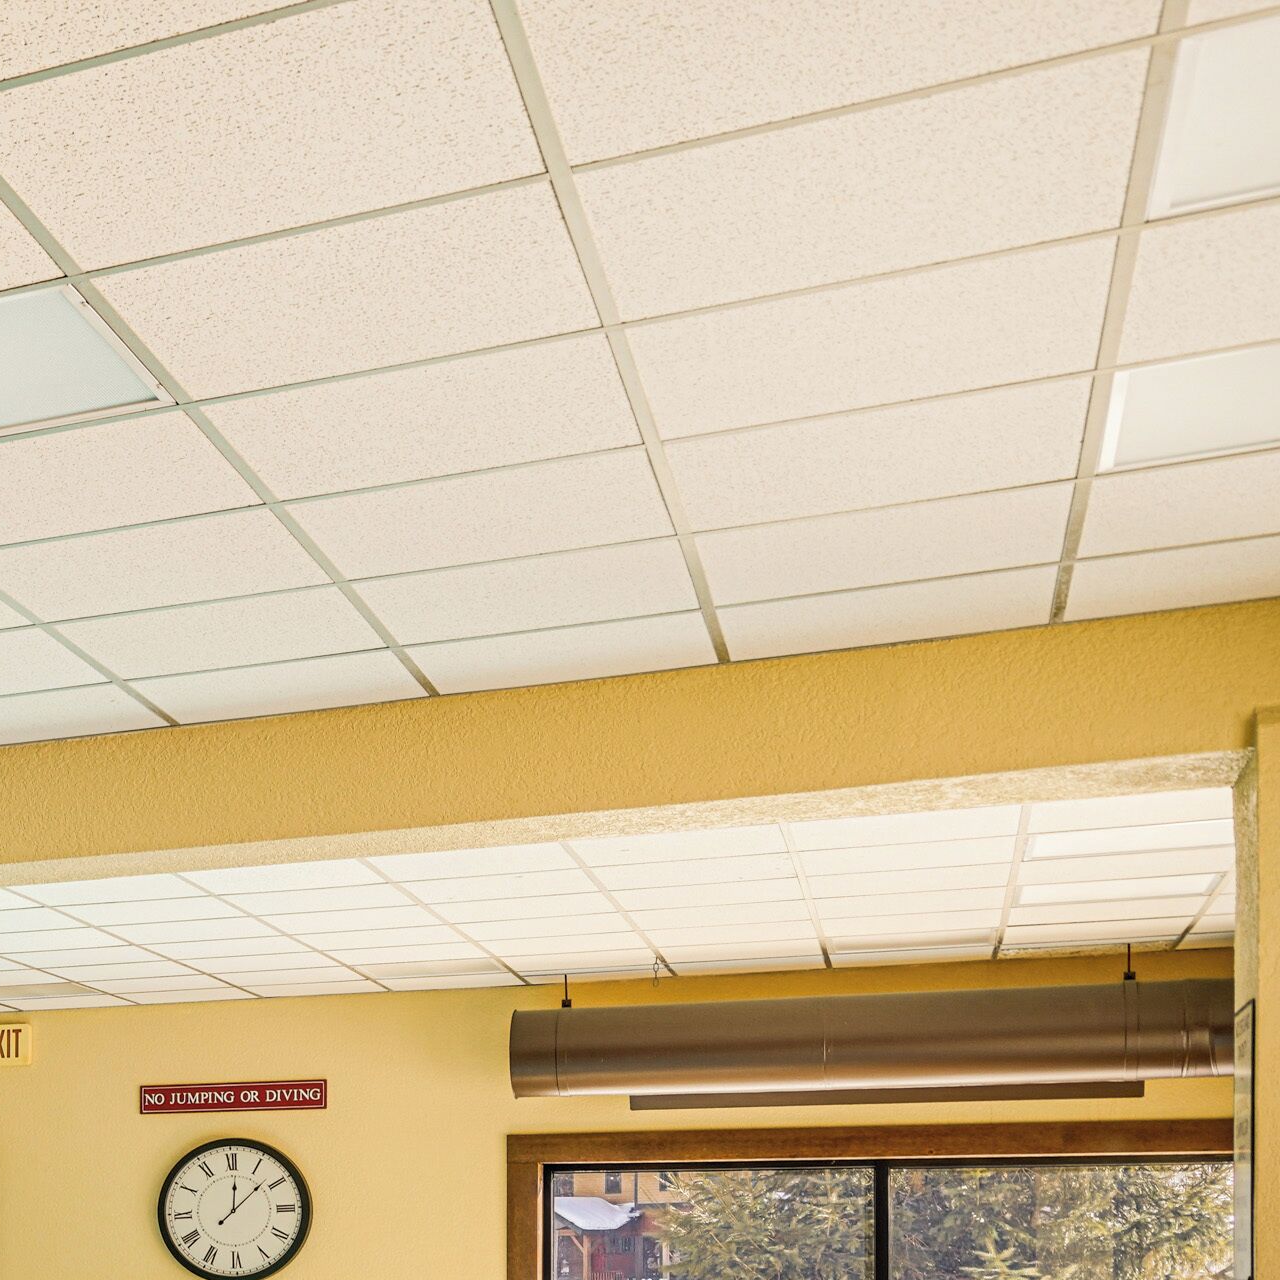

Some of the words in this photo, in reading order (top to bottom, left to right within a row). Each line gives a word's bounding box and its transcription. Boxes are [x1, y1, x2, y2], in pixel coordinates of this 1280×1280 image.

[144, 1093, 165, 1106] NO
[169, 1091, 235, 1105] JUMPING
[240, 1090, 260, 1103] OR
[265, 1088, 322, 1102] DIVING
[198, 1161, 215, 1181] XI
[225, 1153, 239, 1172] XII
[251, 1158, 264, 1175] I
[180, 1183, 198, 1196] X
[268, 1177, 287, 1191] II
[173, 1210, 193, 1220] IX
[276, 1204, 295, 1213] III
[181, 1228, 201, 1249] VIII
[203, 1245, 218, 1266] VII
[230, 1250, 243, 1269] VI
[256, 1245, 270, 1262] V
